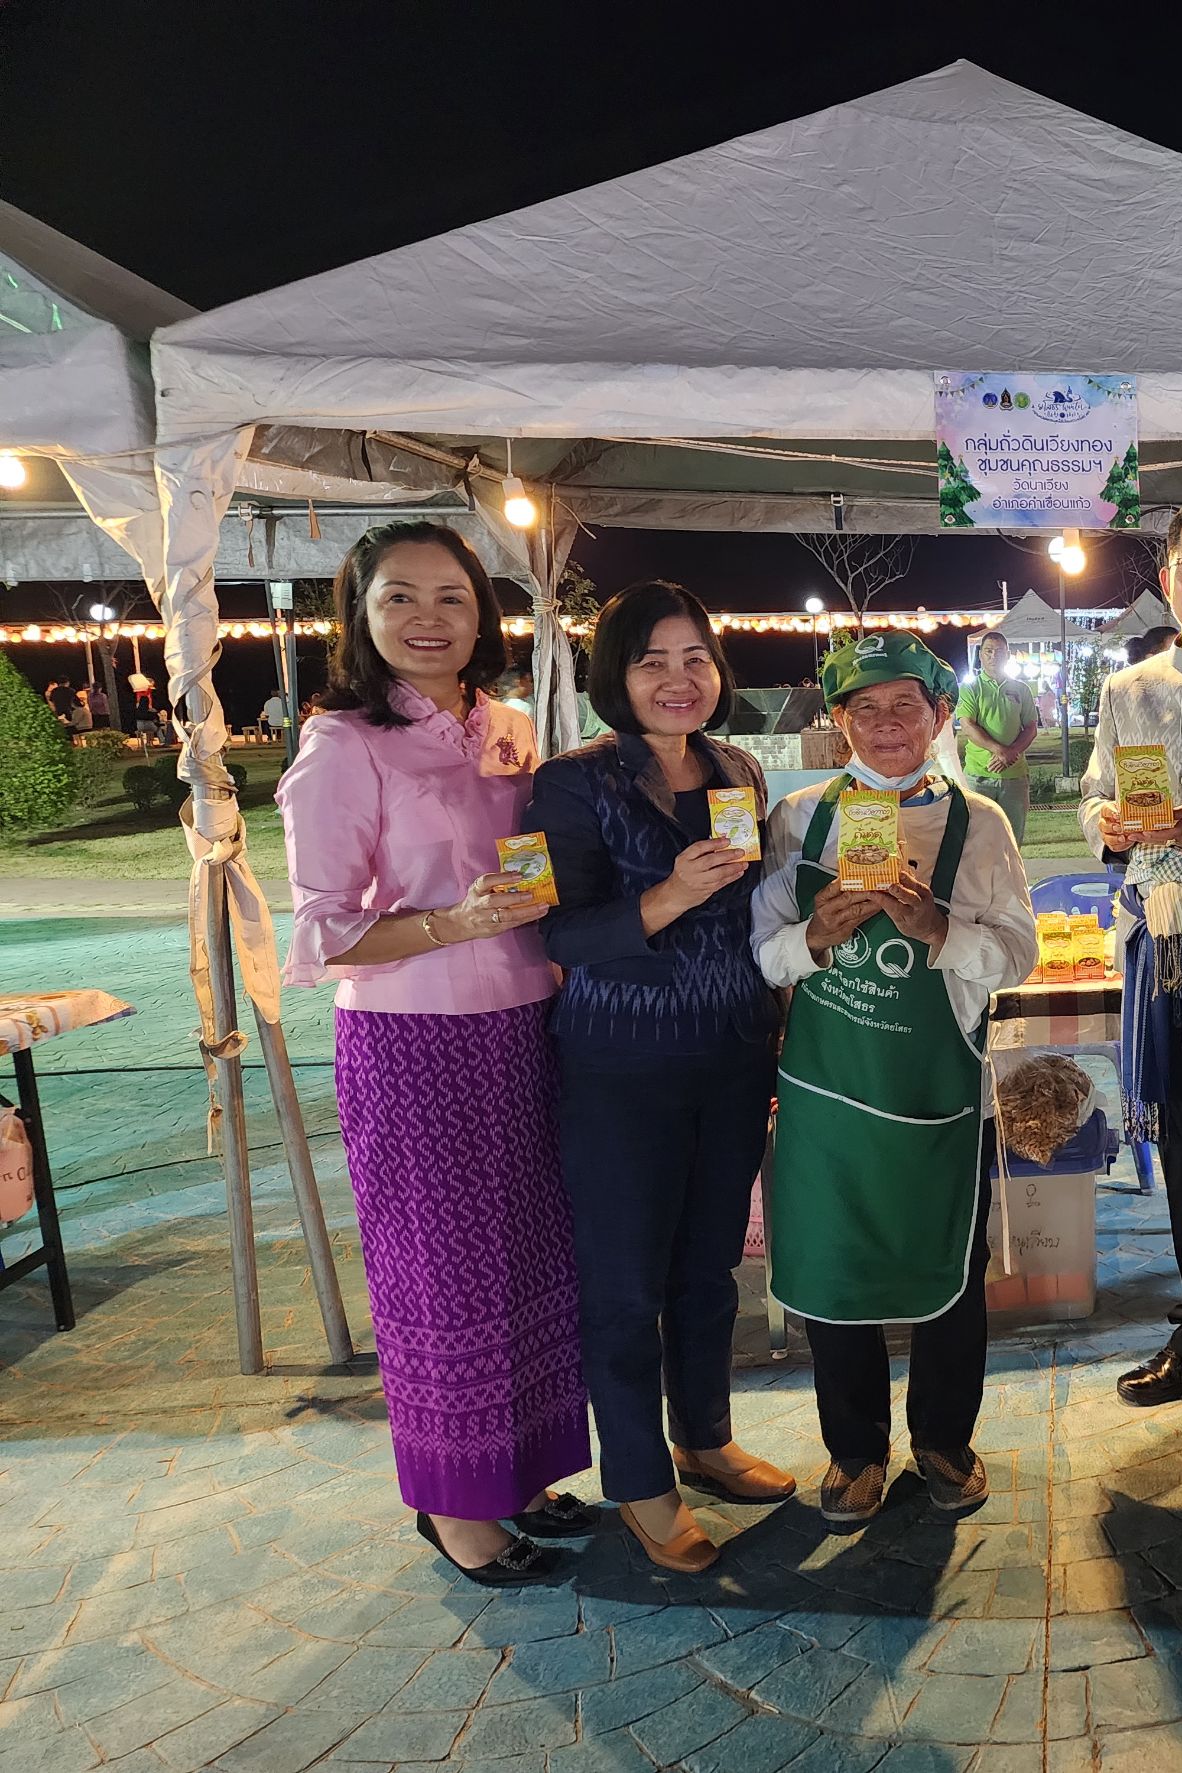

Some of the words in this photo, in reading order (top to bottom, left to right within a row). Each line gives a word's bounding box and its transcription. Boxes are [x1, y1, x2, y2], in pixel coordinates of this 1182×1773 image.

[964, 429, 1113, 454] กลุ่มถั่วดินเวียงทอง
[977, 457, 1103, 475] ชุมชนคุณธรรมฯ
[1013, 478, 1069, 491] วัดนาเวียง
[992, 494, 1091, 509] อำเภอคำเขื่อนแก้ว
